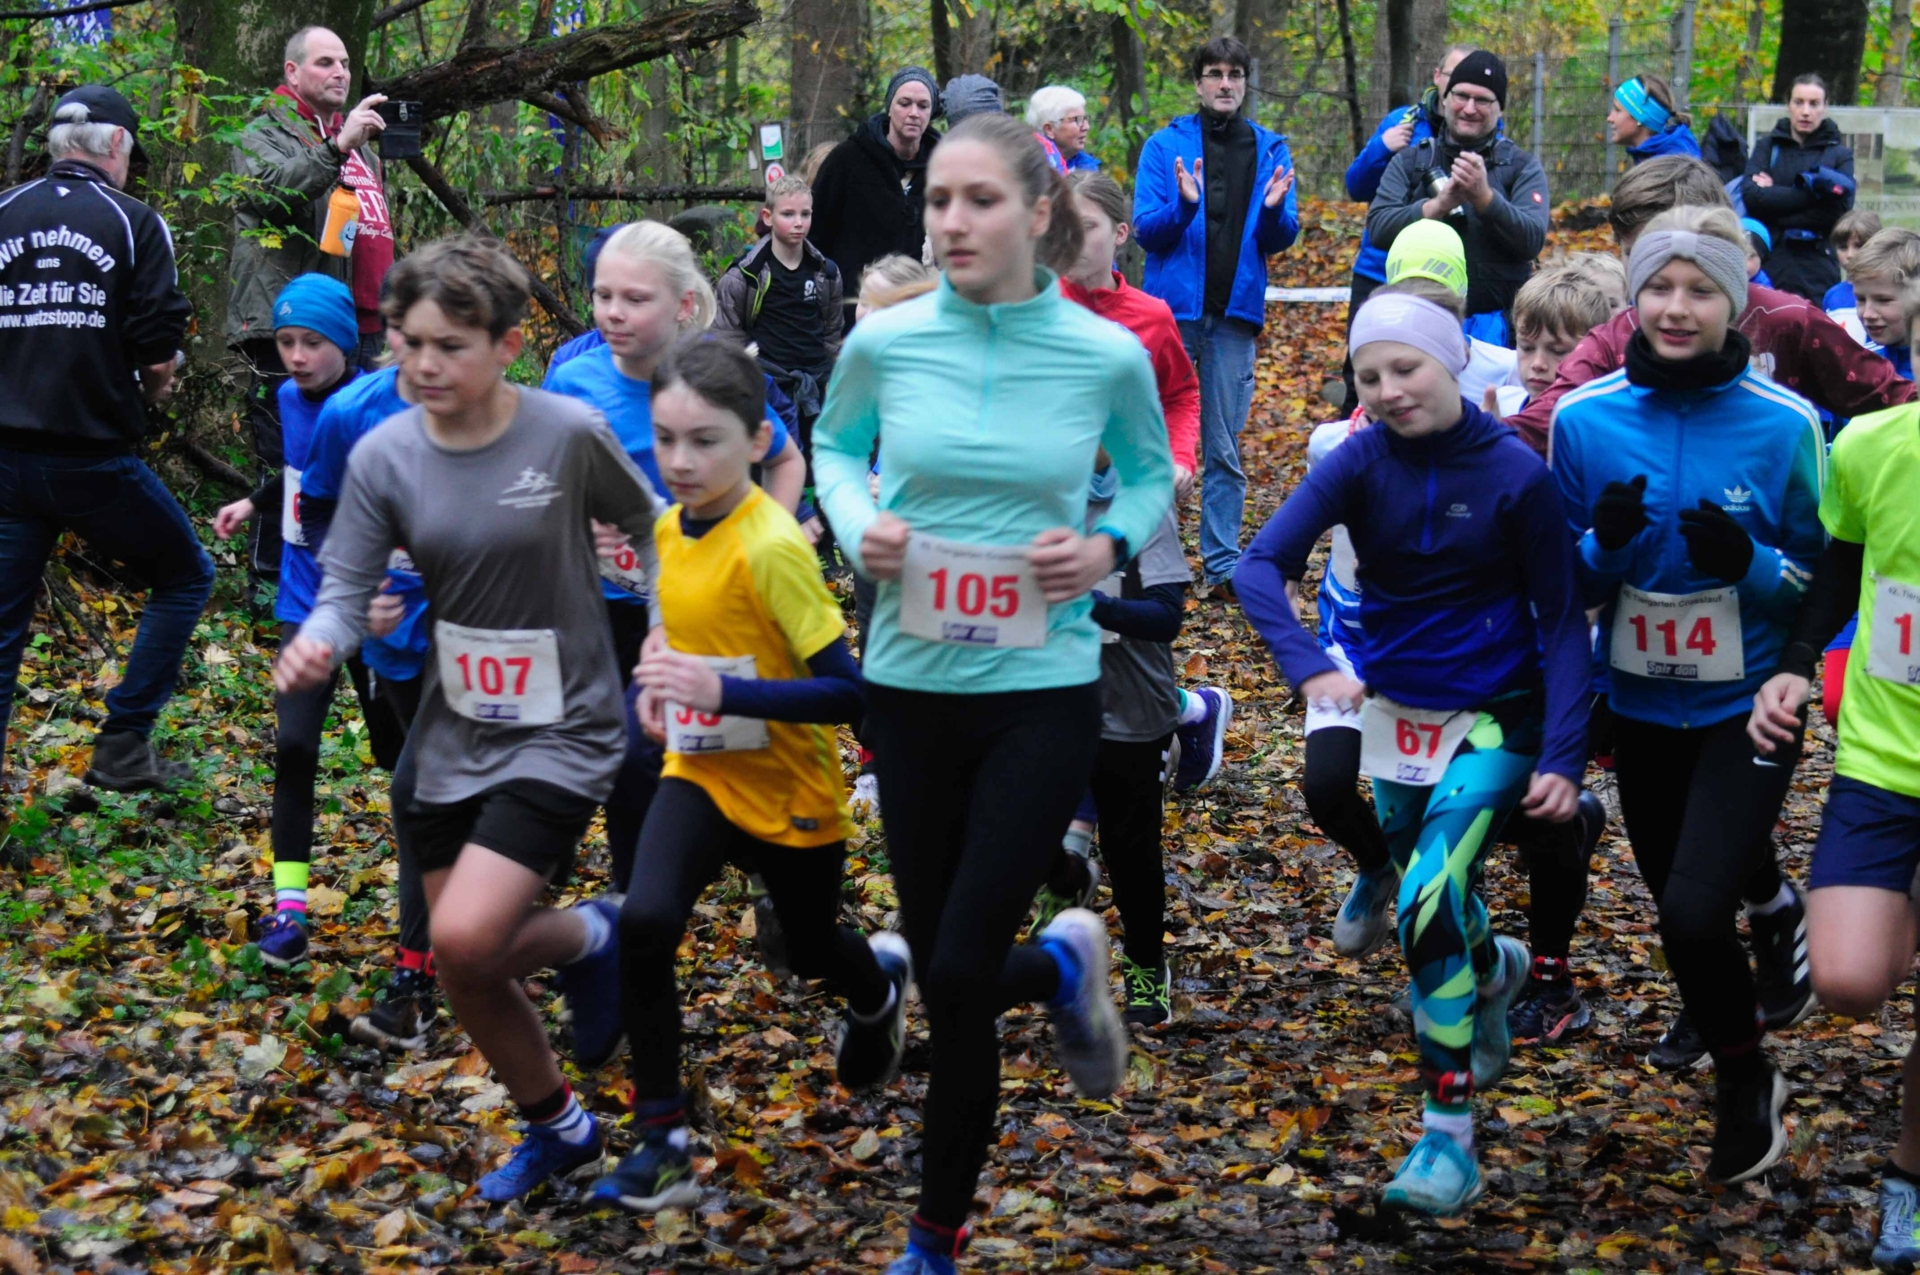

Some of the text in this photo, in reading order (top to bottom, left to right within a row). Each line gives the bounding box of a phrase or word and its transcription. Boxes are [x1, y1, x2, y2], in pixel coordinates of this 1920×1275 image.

[30, 225, 116, 273] nehmen
[37, 257, 61, 269] uns
[18, 283, 48, 306] Zeit
[51, 281, 75, 303] für
[78, 282, 106, 306] Sie
[928, 567, 1020, 619] 105
[1678, 595, 1723, 608] Crosslauf
[1629, 614, 1717, 657] 114
[455, 653, 533, 697] 107
[1395, 717, 1443, 759] 67
